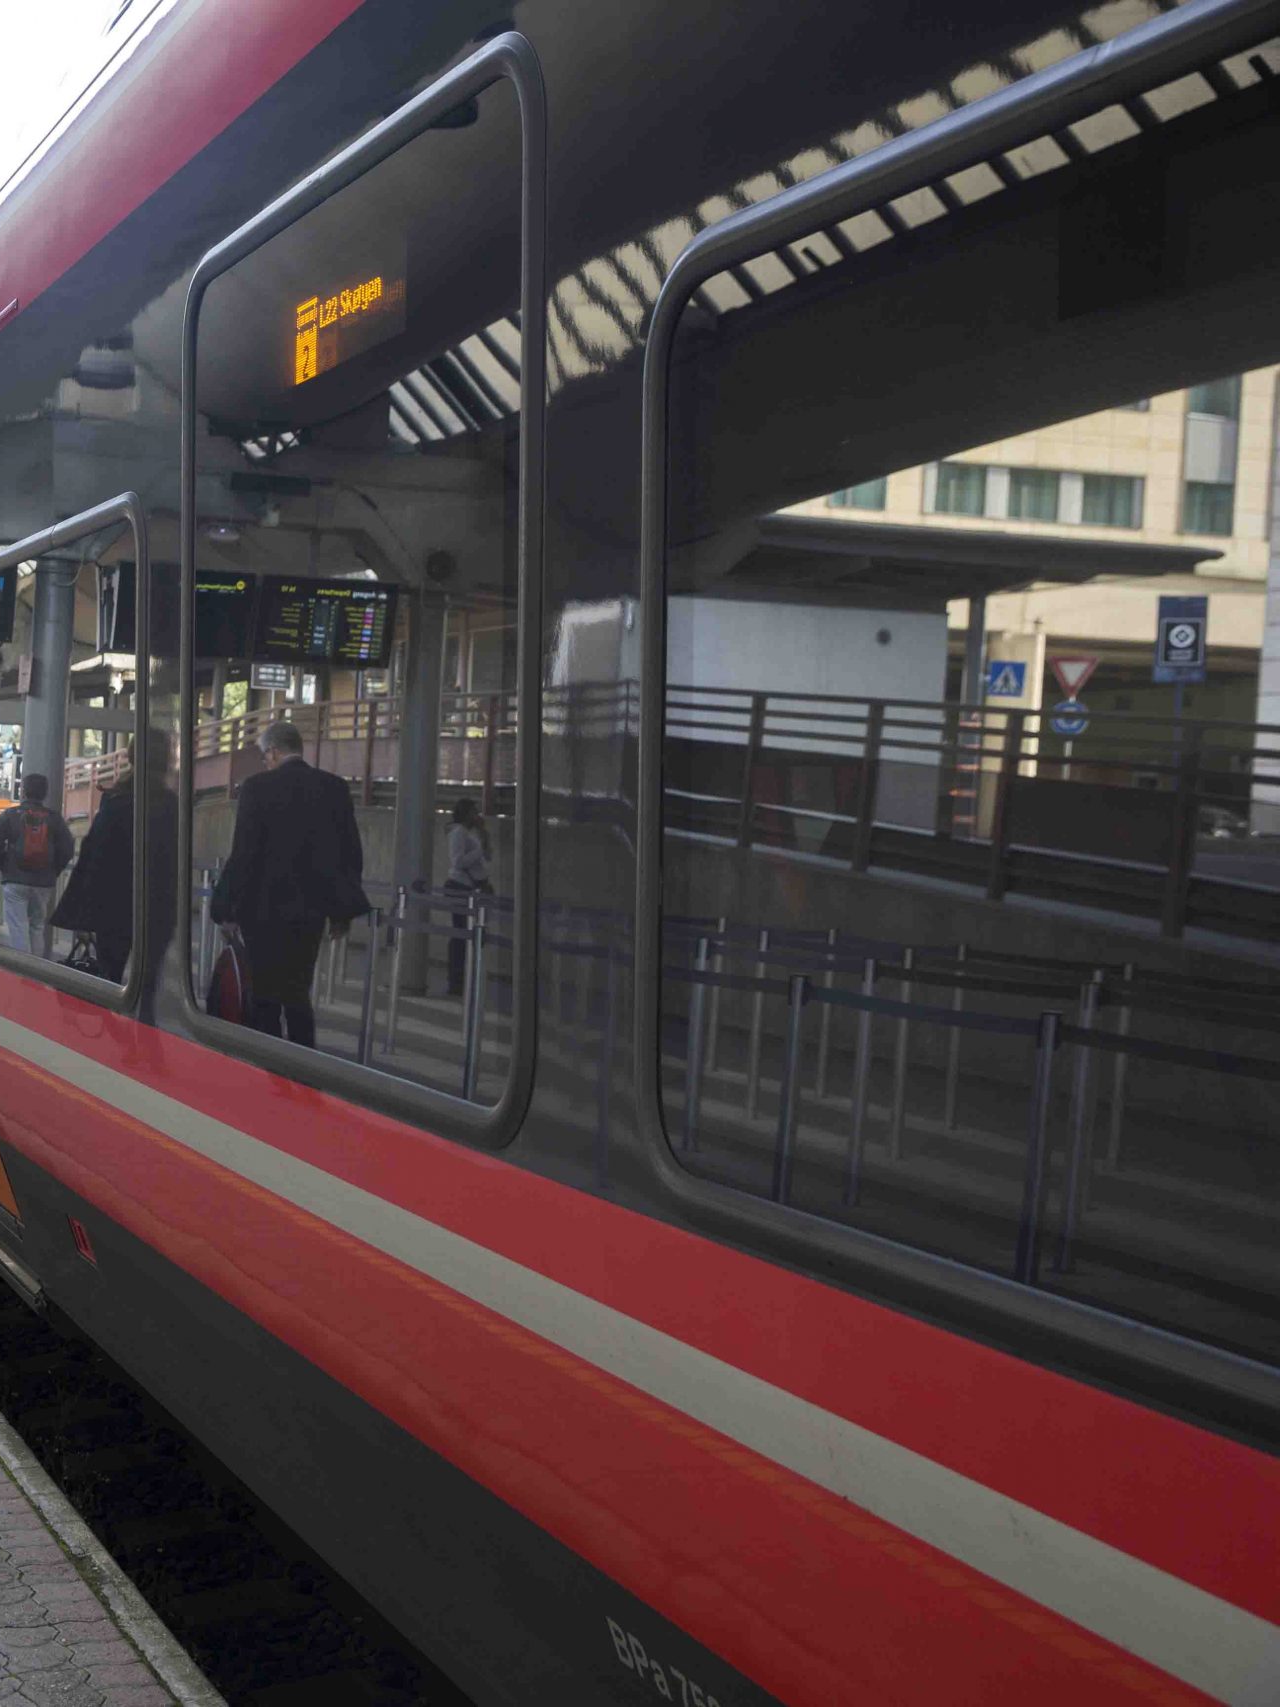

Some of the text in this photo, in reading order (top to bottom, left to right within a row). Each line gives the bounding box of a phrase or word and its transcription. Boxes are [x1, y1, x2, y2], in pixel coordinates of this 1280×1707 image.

[319, 296, 338, 329] L22
[605, 1615, 722, 1707] BPa 75
